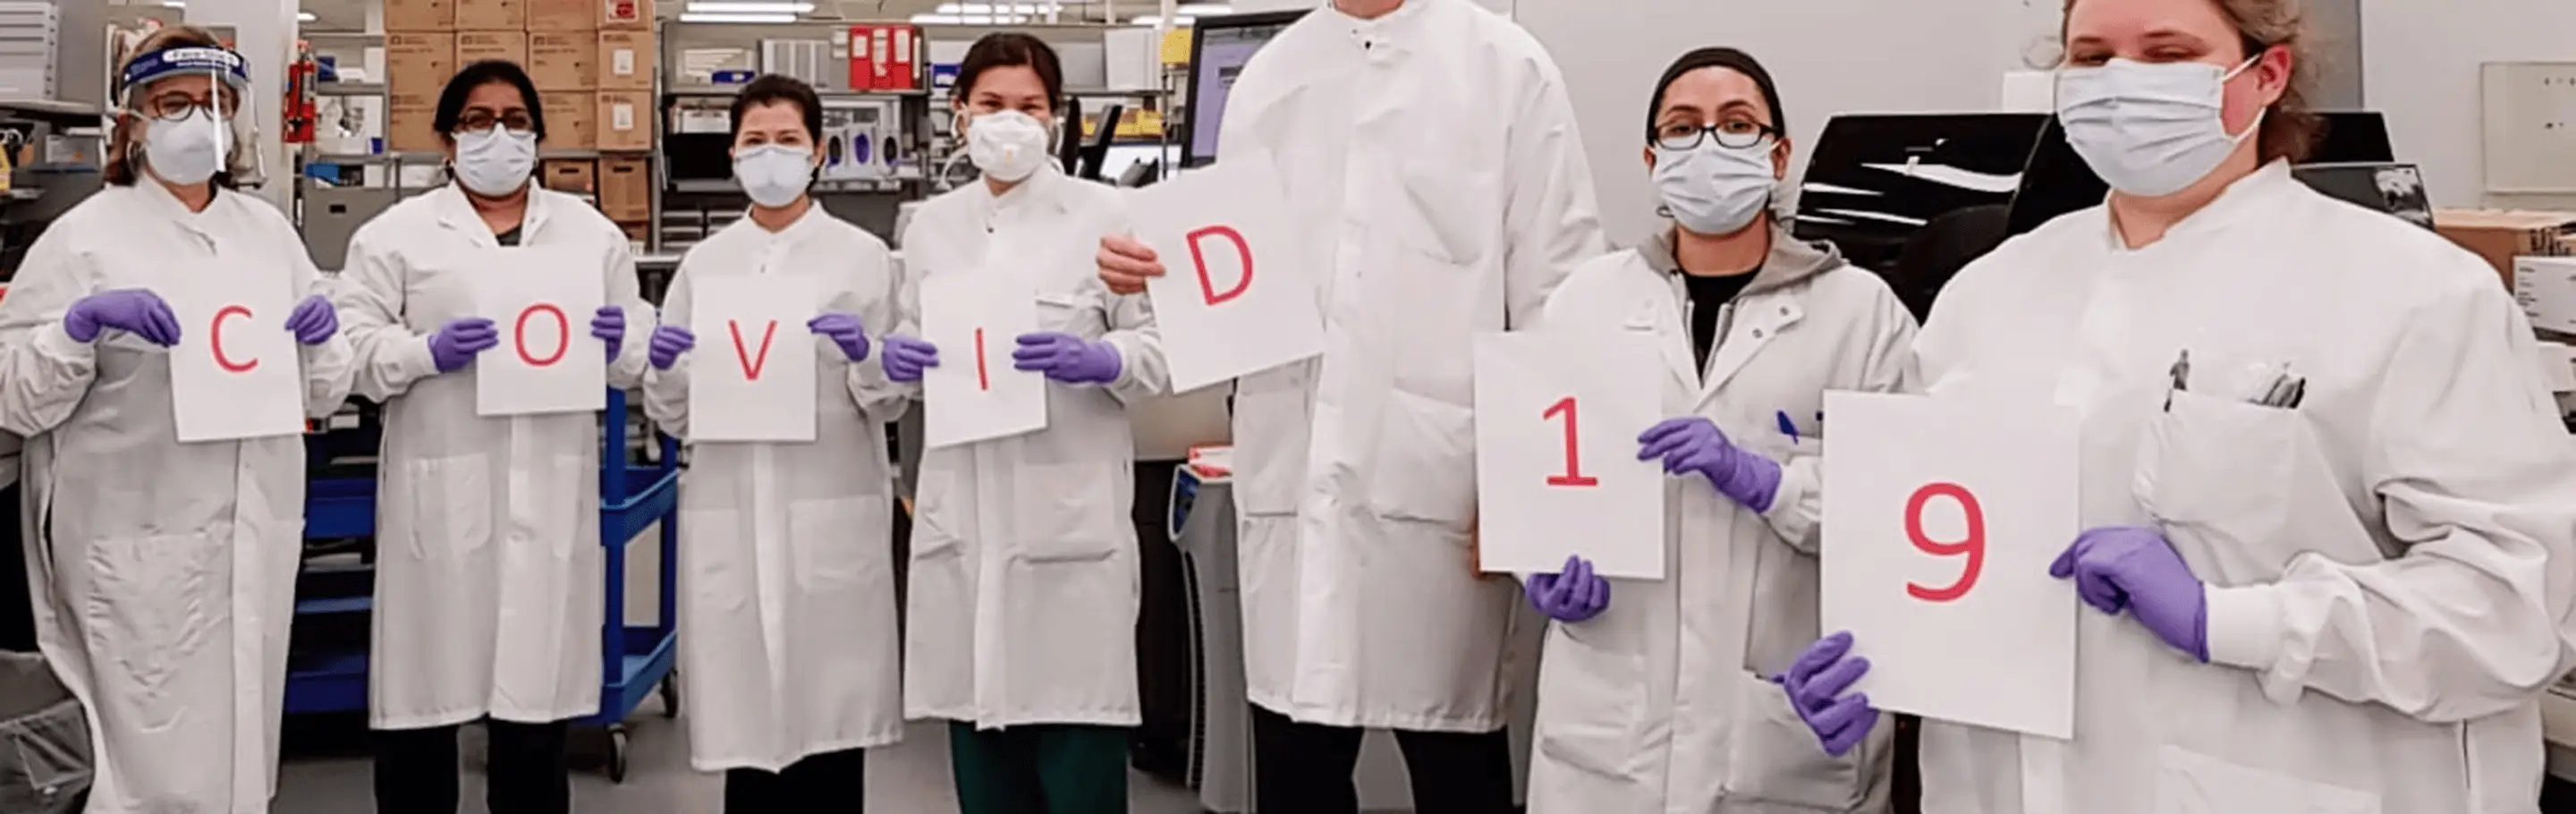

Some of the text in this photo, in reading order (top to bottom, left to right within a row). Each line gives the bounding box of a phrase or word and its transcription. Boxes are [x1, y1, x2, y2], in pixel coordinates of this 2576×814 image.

[1184, 224, 1254, 308] D
[209, 304, 259, 374] C
[513, 302, 571, 368] O
[727, 318, 778, 381] V
[974, 328, 989, 391] I
[1541, 395, 1598, 488] 1
[1902, 480, 1987, 604] 9
